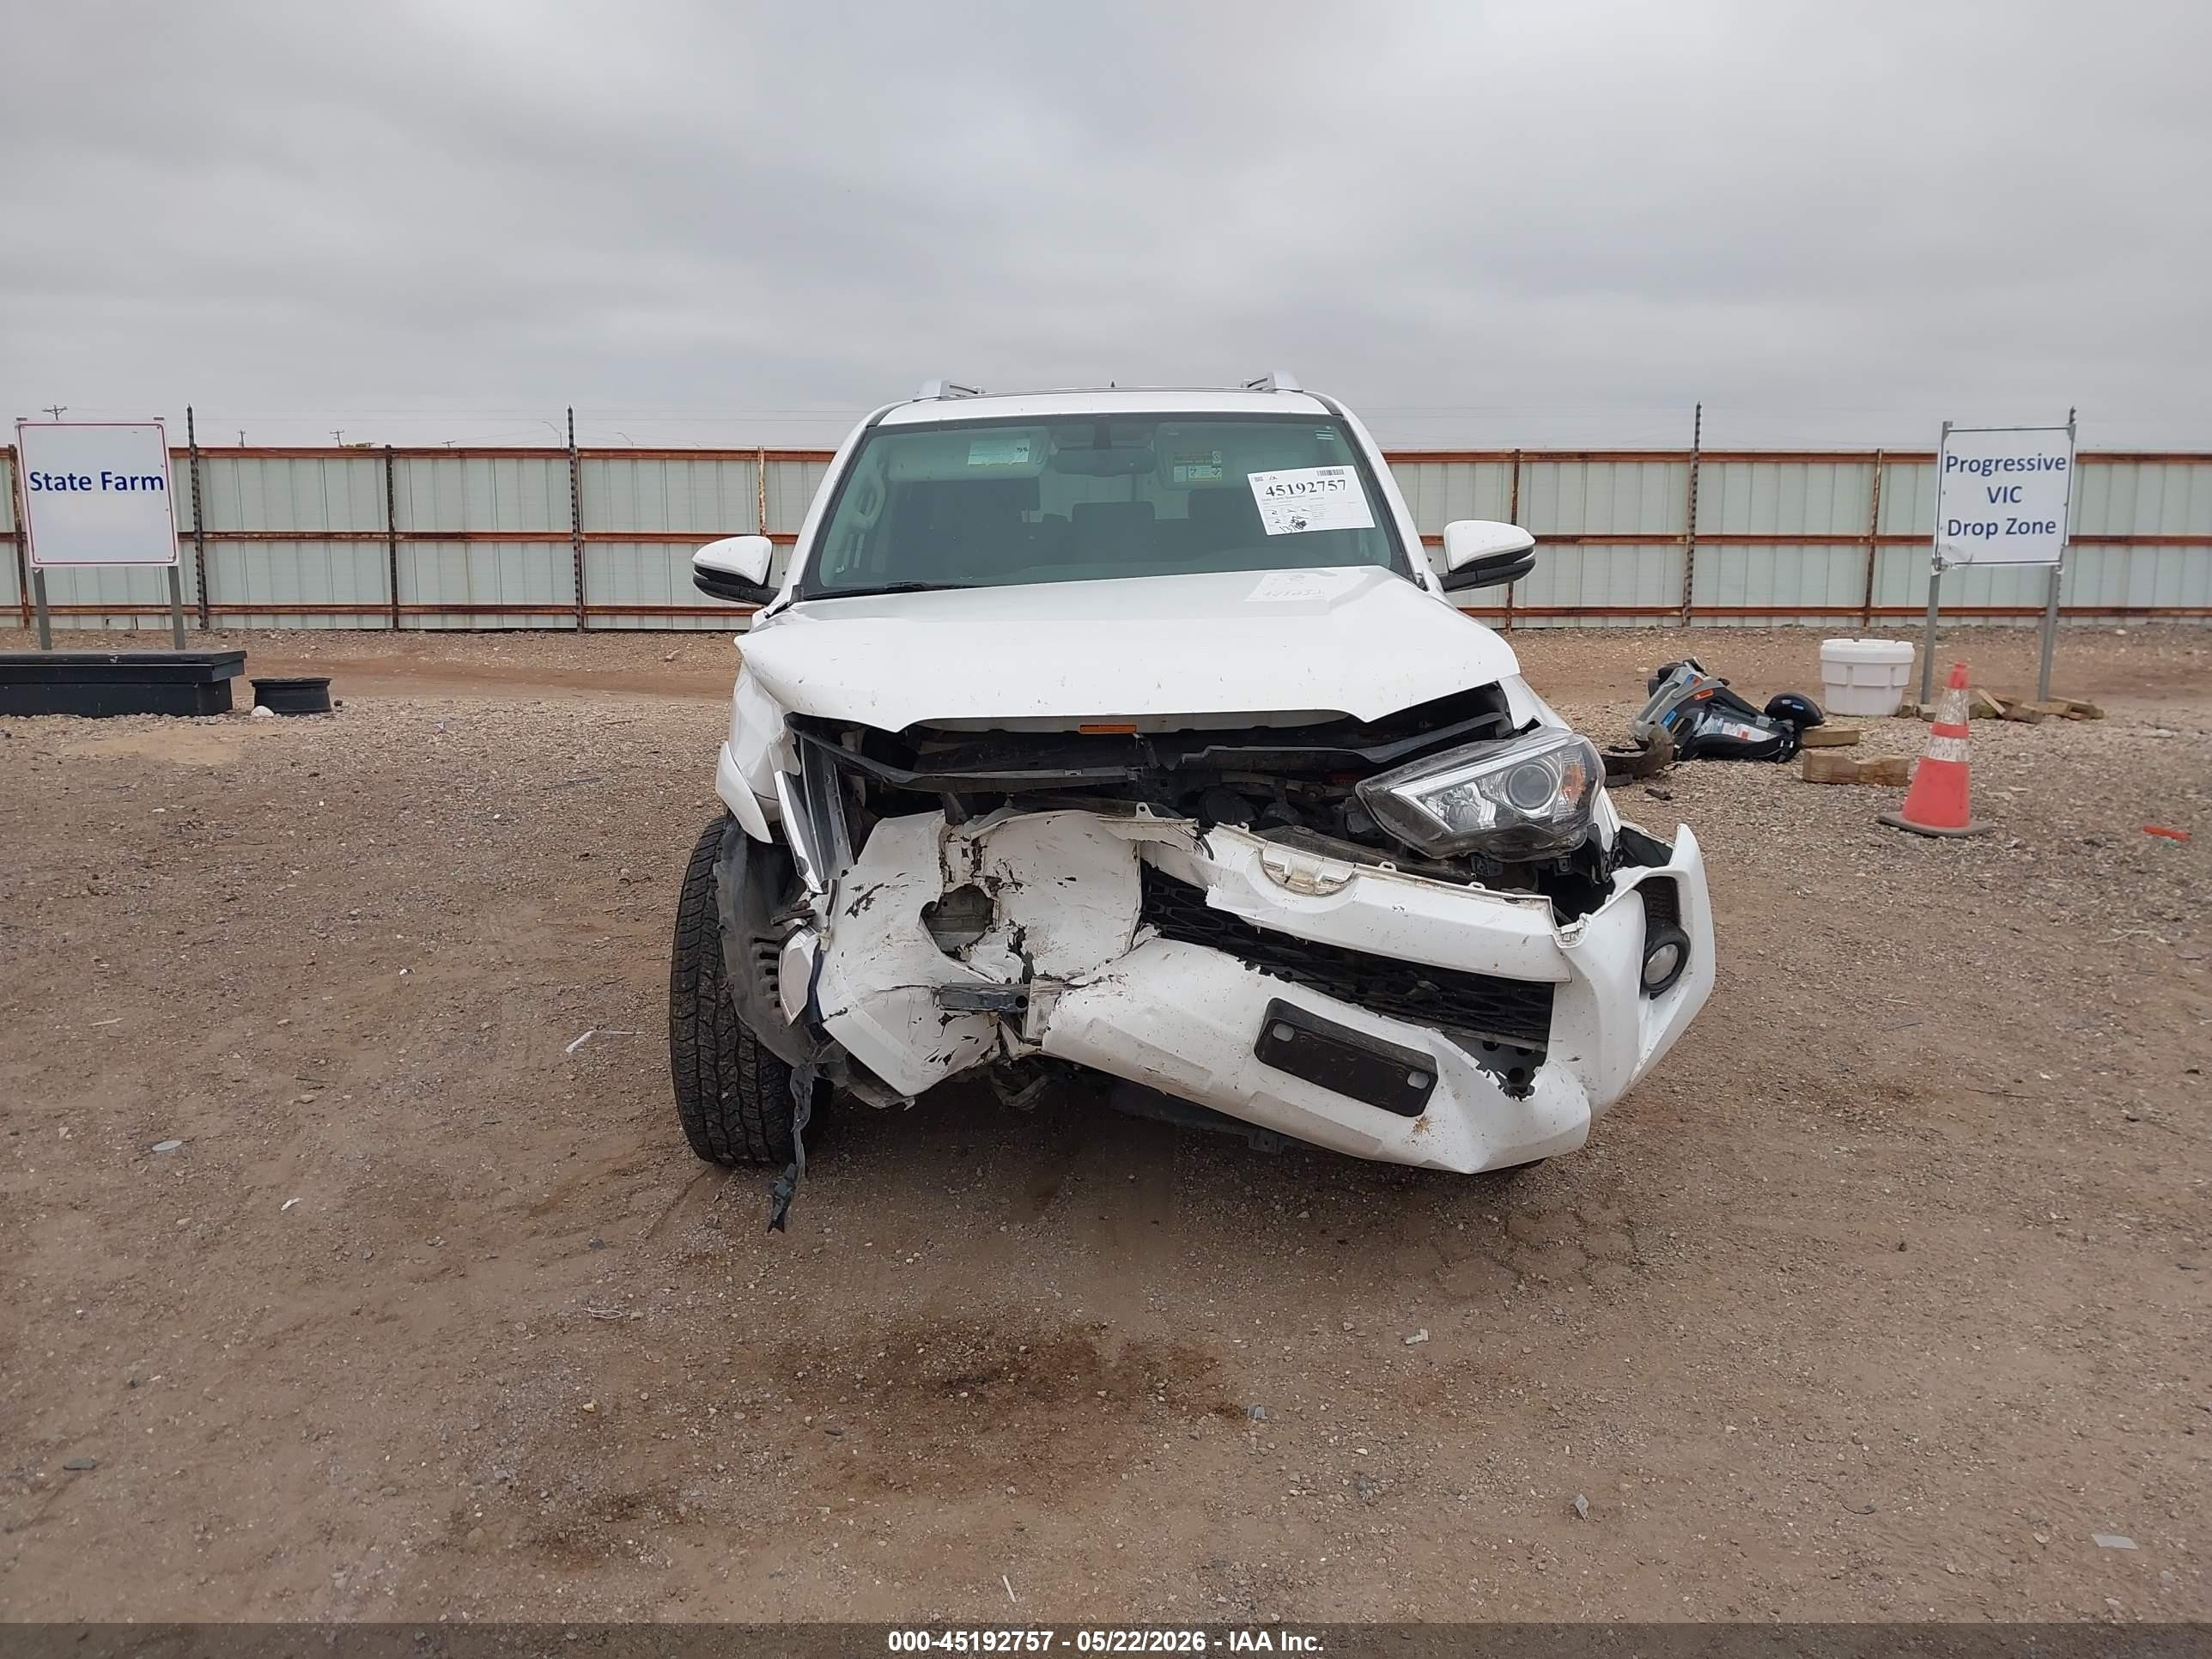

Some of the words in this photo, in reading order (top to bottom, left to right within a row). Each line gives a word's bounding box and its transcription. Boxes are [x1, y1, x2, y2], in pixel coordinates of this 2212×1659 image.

[1946, 453, 2066, 477] Progressive
[29, 471, 92, 491] State
[100, 471, 164, 491] Farm
[1265, 479, 1346, 496] 45192757
[1986, 485, 2022, 503] VIC
[1948, 519, 1998, 539] Drop
[2005, 518, 2057, 535] Zone
